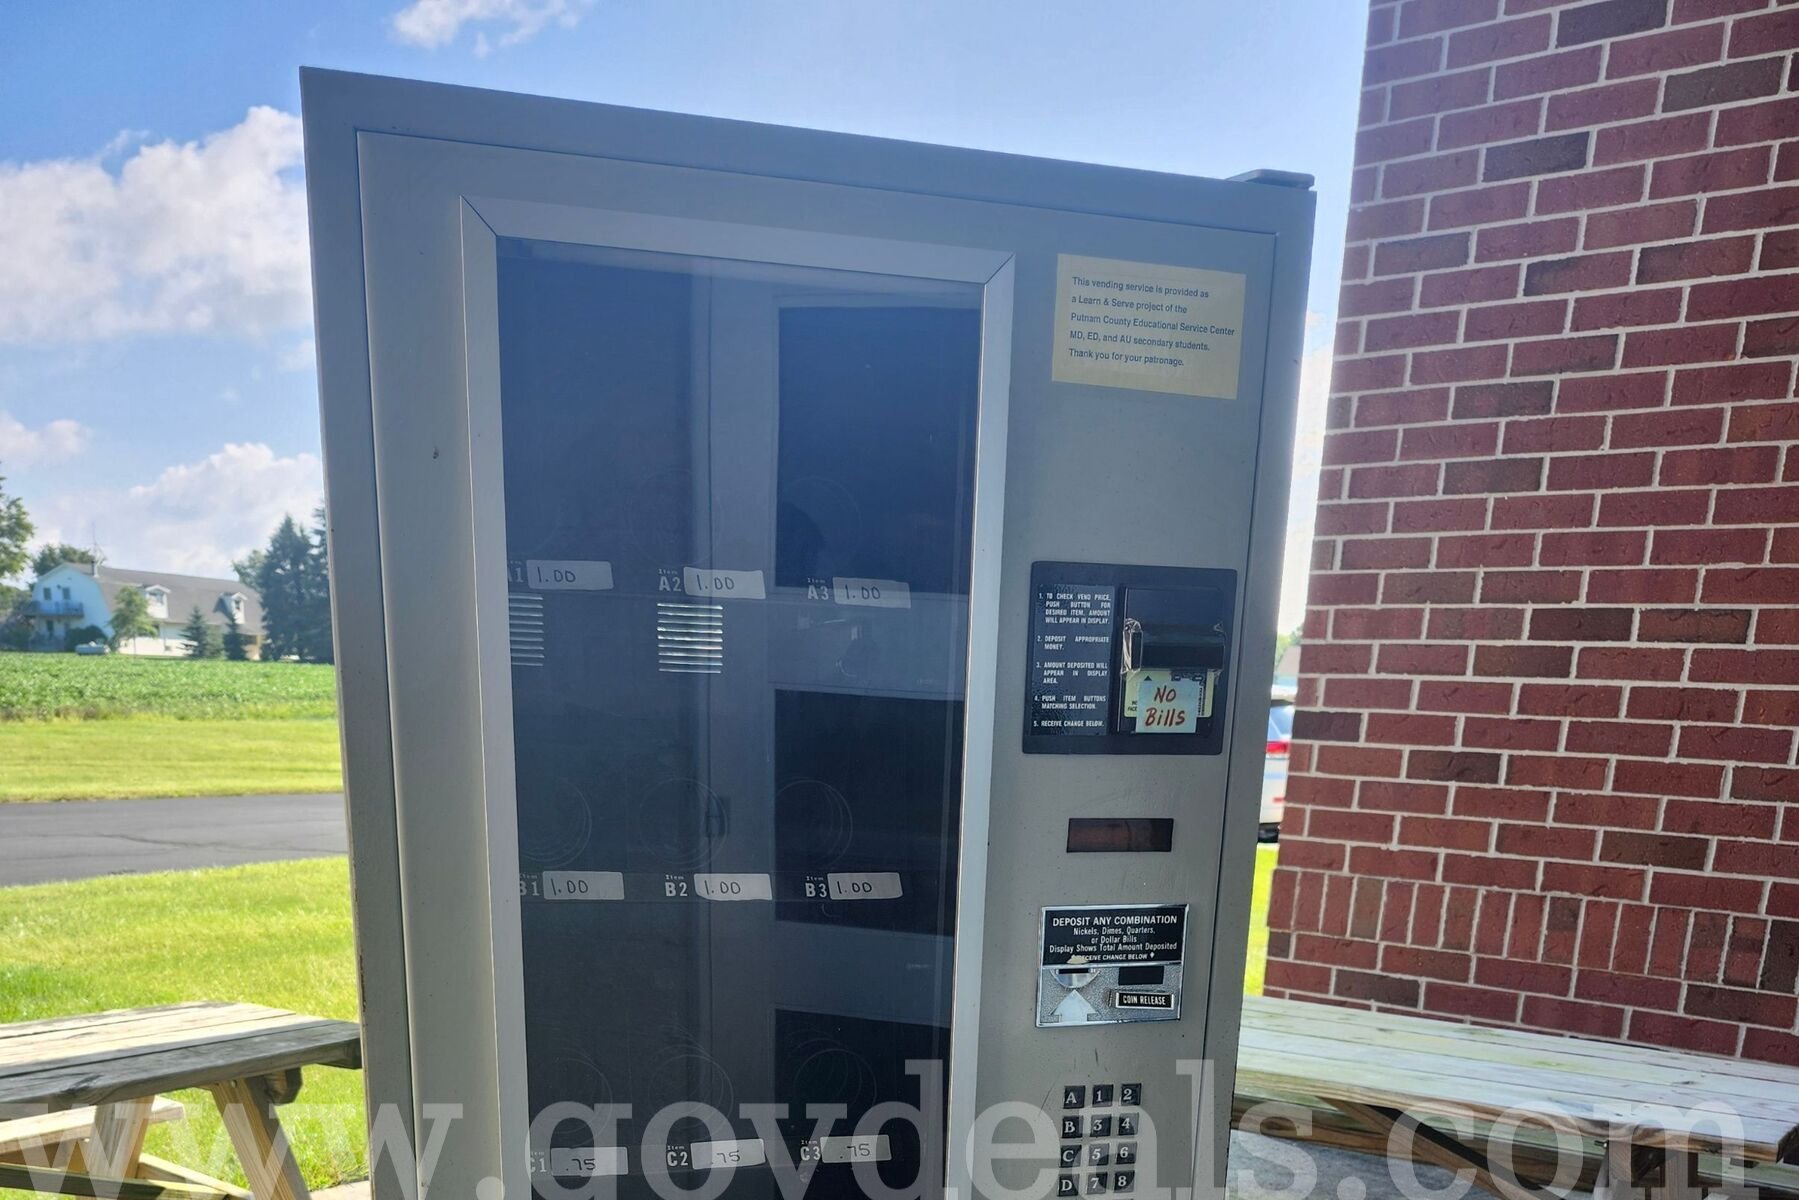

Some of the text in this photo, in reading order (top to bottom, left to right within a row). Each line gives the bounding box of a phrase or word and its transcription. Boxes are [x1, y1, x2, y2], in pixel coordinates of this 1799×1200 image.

[1072, 276, 1209, 298] This vending service is provided as
[1078, 296, 1101, 305] Learn
[1103, 298, 1109, 306] &
[1111, 298, 1135, 308] Serve
[1136, 302, 1164, 312] project
[1165, 304, 1173, 312] of
[1175, 304, 1188, 314] the
[1071, 312, 1235, 336] Putnam County Educational Service Center
[1070, 330, 1210, 351] MD, ED, and AU secondary students.
[1069, 348, 1184, 368] Thank you for your patronage.
[536, 566, 576, 583] 1.00
[659, 576, 682, 592] A2
[696, 574, 735, 591] 1.00
[808, 585, 829, 600] A3
[845, 584, 881, 600] 1.00
[1046, 600, 1060, 608] PUSH
[1045, 608, 1068, 616] DESIRED
[1041, 702, 1068, 710] MATCHING
[1145, 707, 1186, 728] Bills
[550, 878, 589, 896] 1.00
[664, 882, 688, 897] B2
[704, 880, 741, 896] 1.00
[805, 882, 828, 898] B3
[836, 880, 872, 894] 1.00
[1052, 915, 1178, 927] DEPOSIT ANY COMBINATION
[1126, 926, 1156, 935] Quarters,
[1100, 936, 1121, 944] Dollar
[1049, 942, 1178, 954] Display Shows Total Amount Deposited
[1122, 995, 1166, 1006] COIN RELEASE
[1066, 1091, 1077, 1104] A
[1096, 1090, 1102, 1102] 1
[1124, 1088, 1132, 1100] 2
[1064, 1121, 1076, 1134] B
[1094, 1119, 1102, 1132] 3
[1121, 1117, 1130, 1129] 4
[800, 1146, 820, 1161] C3
[840, 1143, 871, 1159] .75
[1062, 1150, 1074, 1163] C
[1092, 1148, 1101, 1160] 5
[1120, 1146, 1129, 1158] 6
[566, 1158, 596, 1171] .75
[667, 1151, 688, 1166] C2
[1061, 1180, 1072, 1192] D
[1090, 1178, 1099, 1188] 7
[1118, 1176, 1127, 1186] 8
